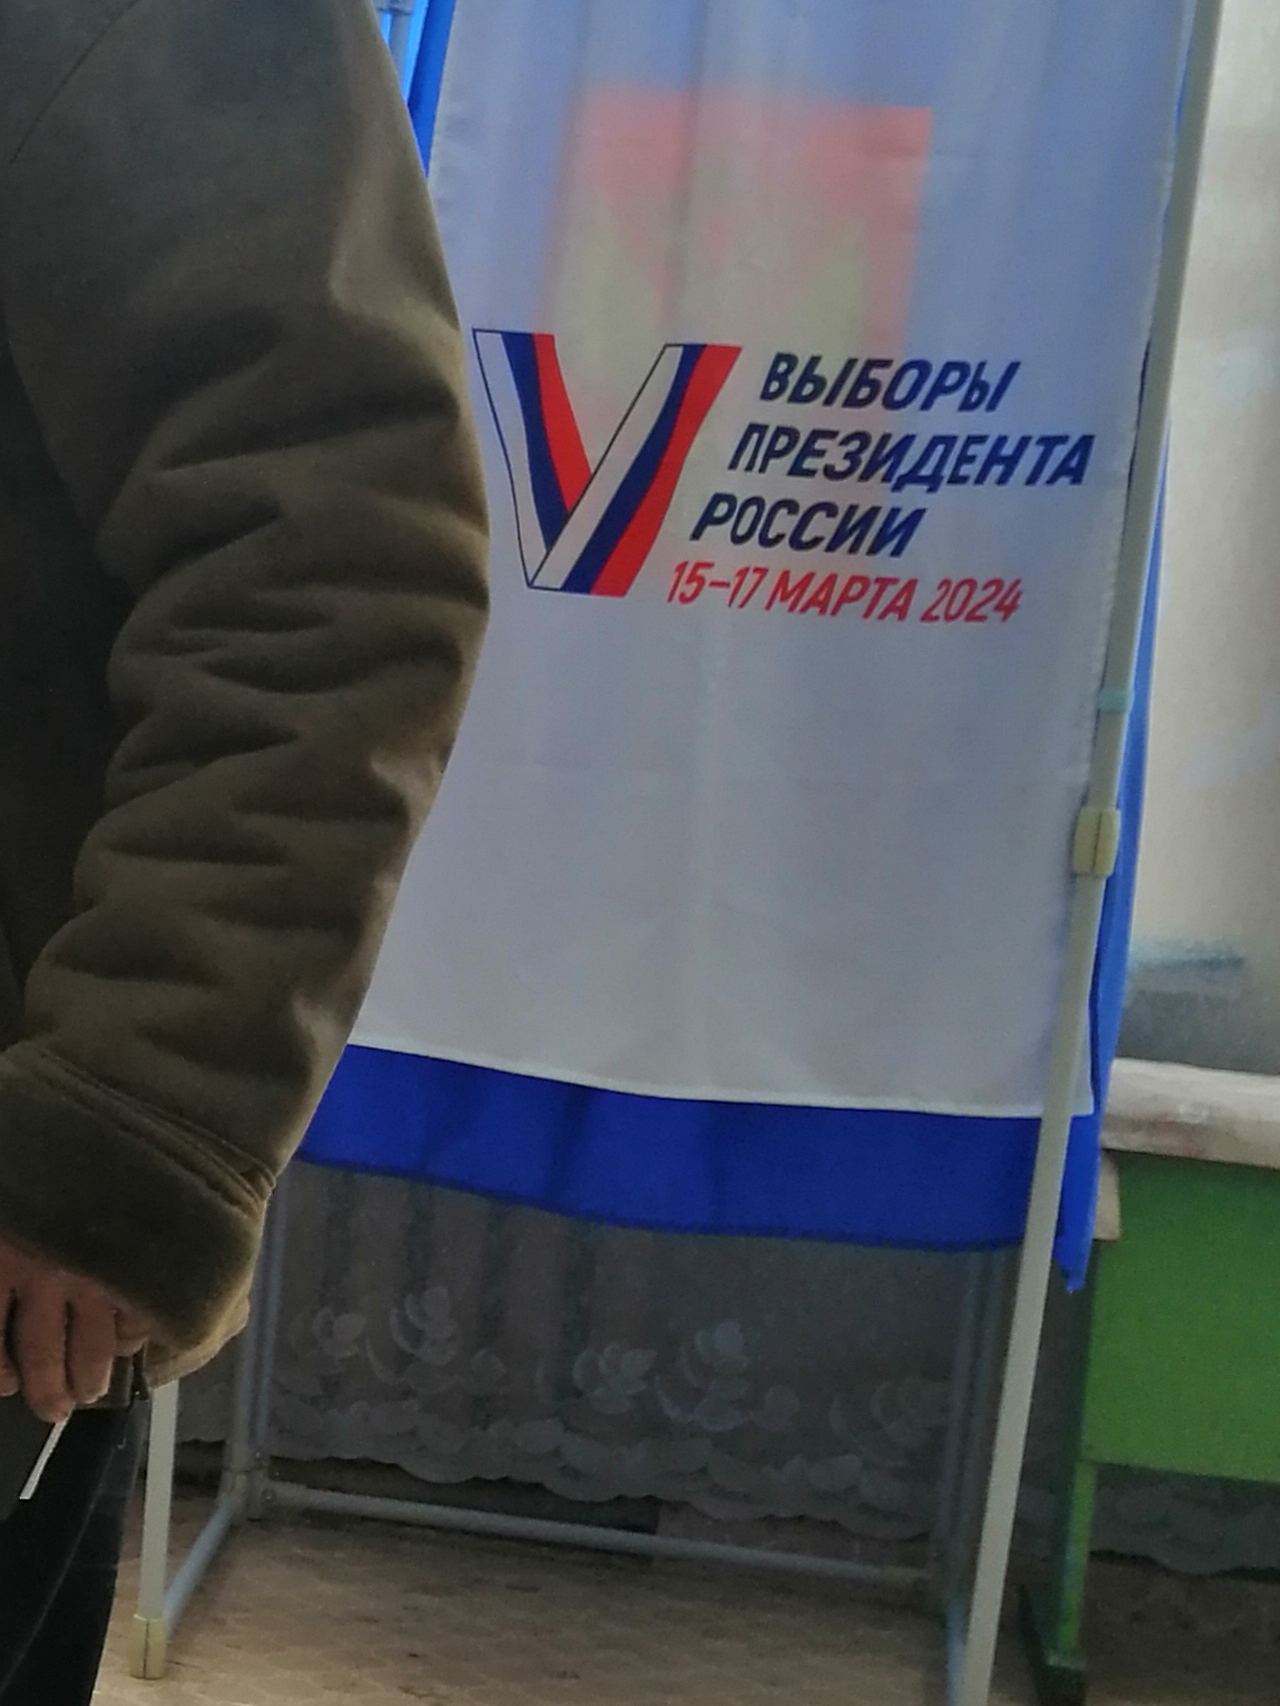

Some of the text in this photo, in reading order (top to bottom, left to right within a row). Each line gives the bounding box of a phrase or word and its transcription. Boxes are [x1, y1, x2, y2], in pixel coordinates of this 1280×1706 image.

[759, 352, 1021, 412] ВЫБОРЫ
[727, 422, 1096, 494] ПРЕЗИДЕНТА
[689, 492, 927, 558] РОССИИ
[764, 568, 917, 621] МАРТА
[919, 577, 1024, 623] 2024
